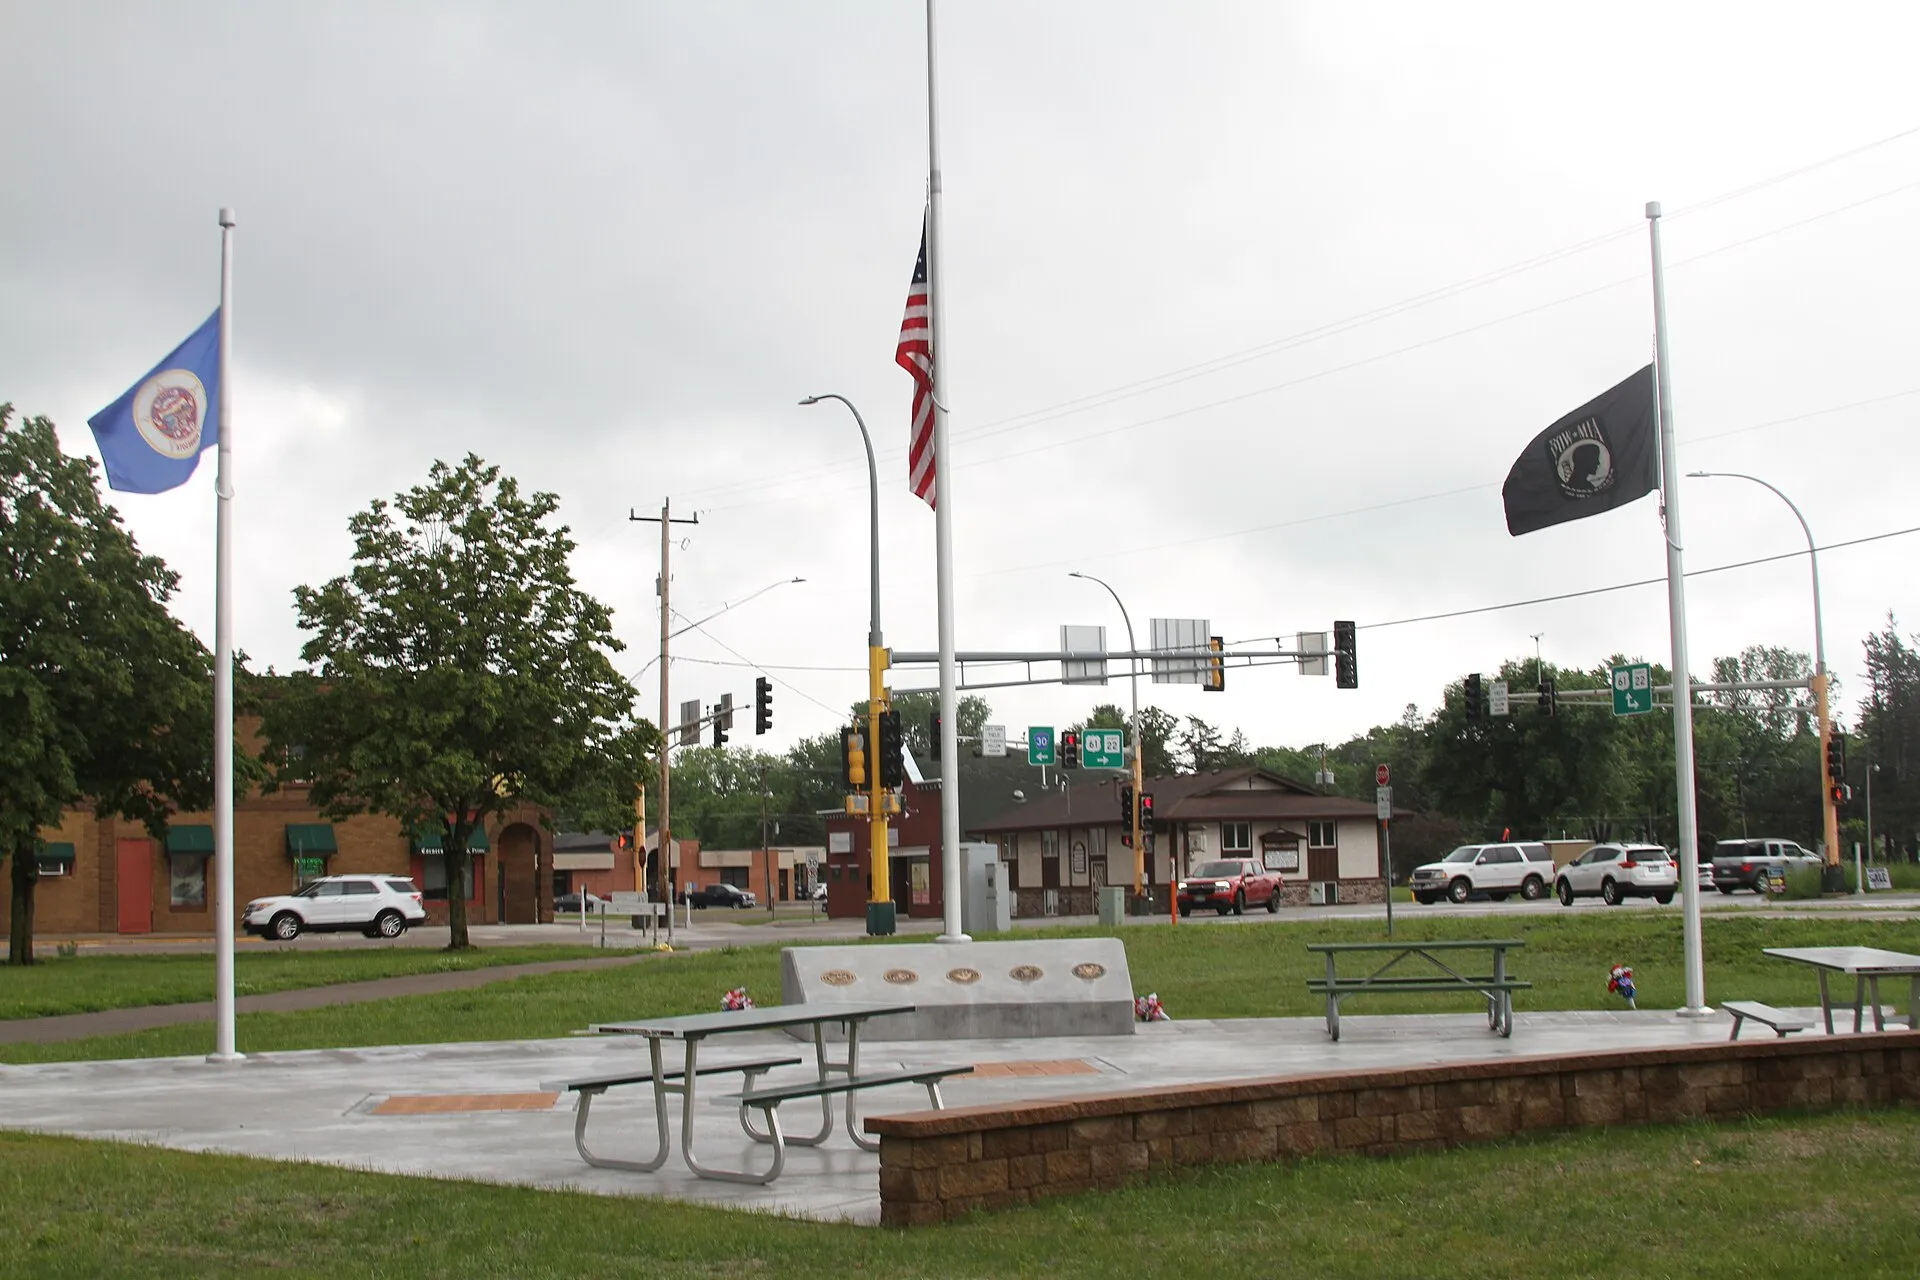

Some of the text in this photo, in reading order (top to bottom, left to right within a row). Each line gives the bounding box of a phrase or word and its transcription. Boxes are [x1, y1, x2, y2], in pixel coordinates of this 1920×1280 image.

[1549, 416, 1605, 466] POW MIA
[1618, 676, 1627, 686] 61
[1635, 675, 1645, 686] 22
[1036, 737, 1047, 746] 30
[1089, 741, 1098, 749] 61
[1107, 741, 1117, 751] 22
